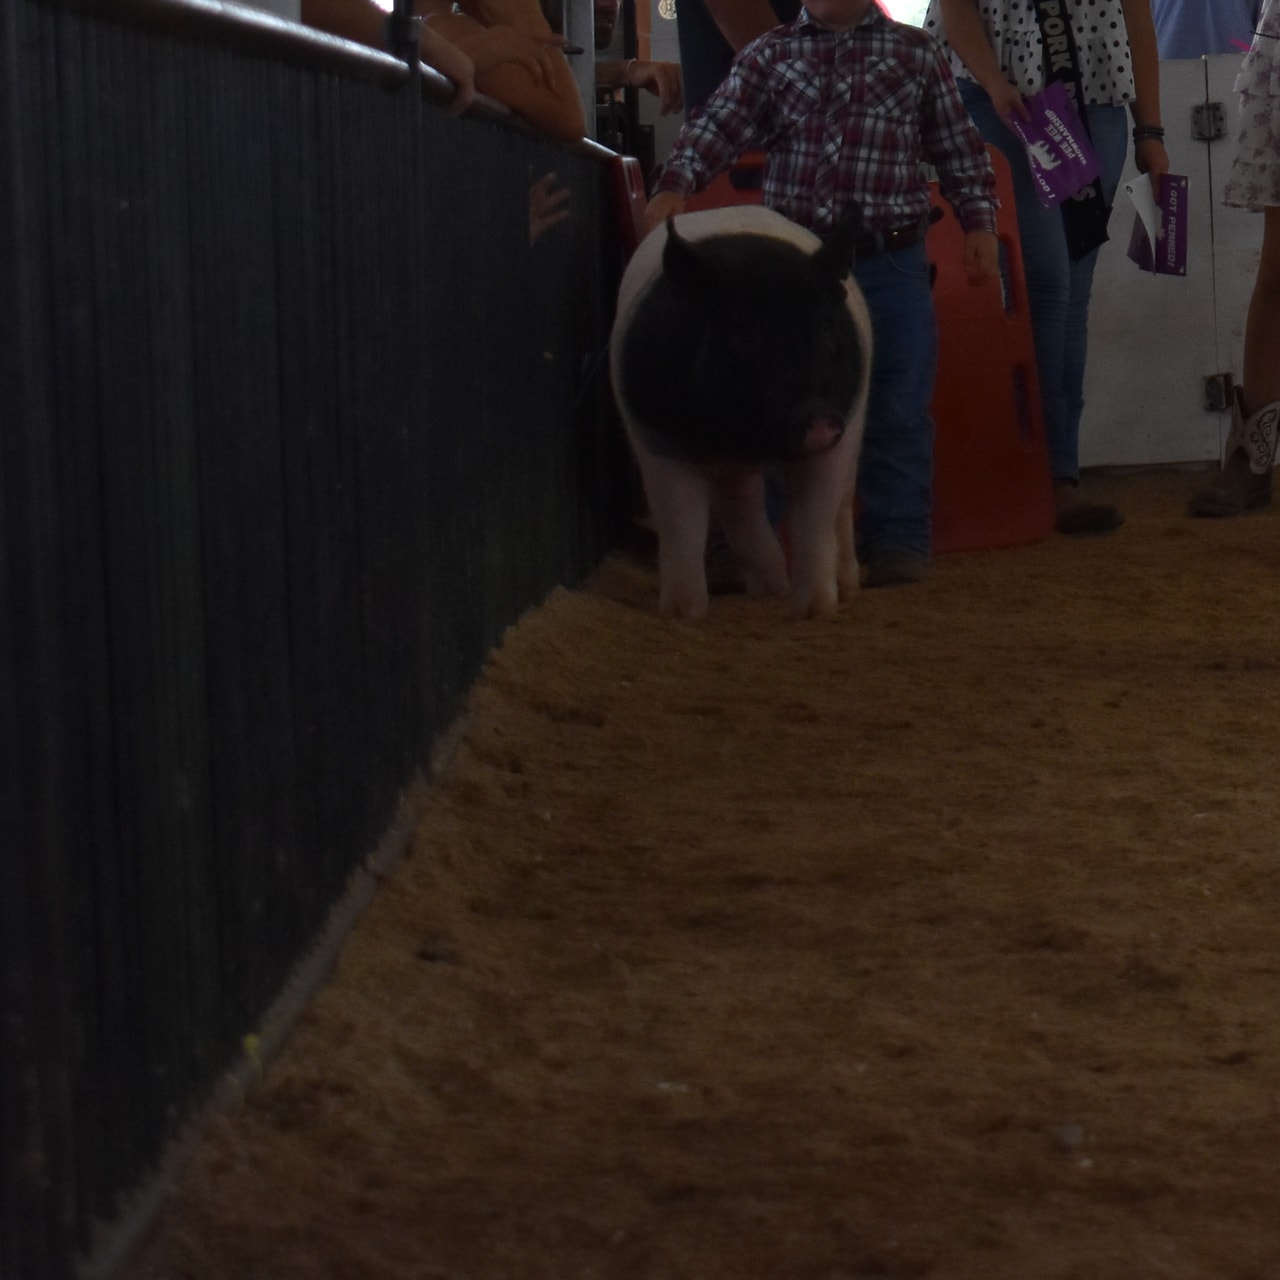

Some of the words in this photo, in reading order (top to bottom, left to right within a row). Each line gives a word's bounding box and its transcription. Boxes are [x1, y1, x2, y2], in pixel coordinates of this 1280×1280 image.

[1039, 0, 1073, 73] PORK
[1168, 191, 1178, 212] GOT
[1167, 217, 1178, 269] PENNED!
